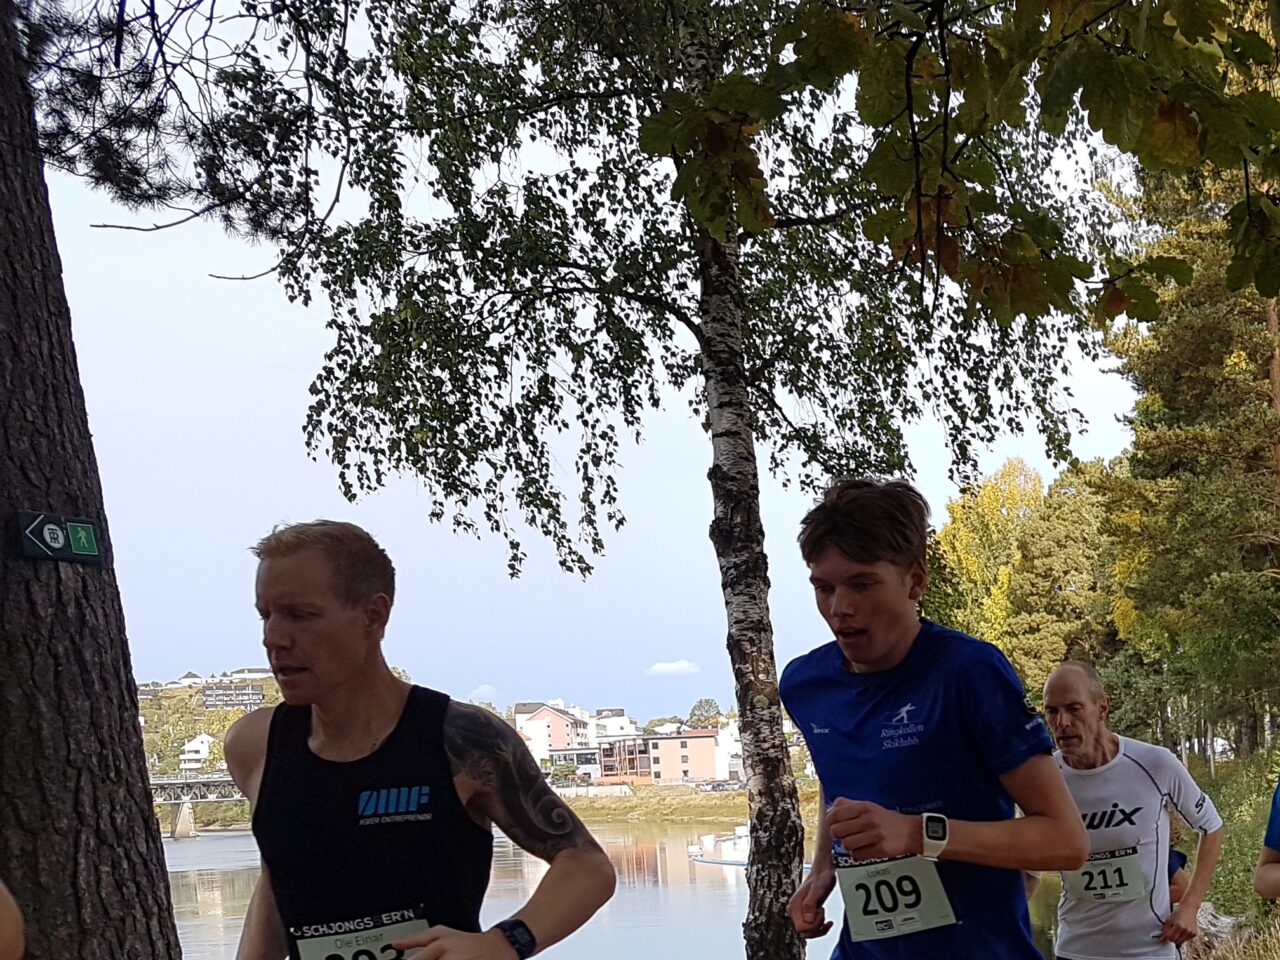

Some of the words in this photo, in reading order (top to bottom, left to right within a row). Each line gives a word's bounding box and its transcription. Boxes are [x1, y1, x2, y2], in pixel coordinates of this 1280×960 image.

[1081, 802, 1144, 831] wix
[1081, 866, 1129, 892] 211
[854, 874, 922, 917] 209
